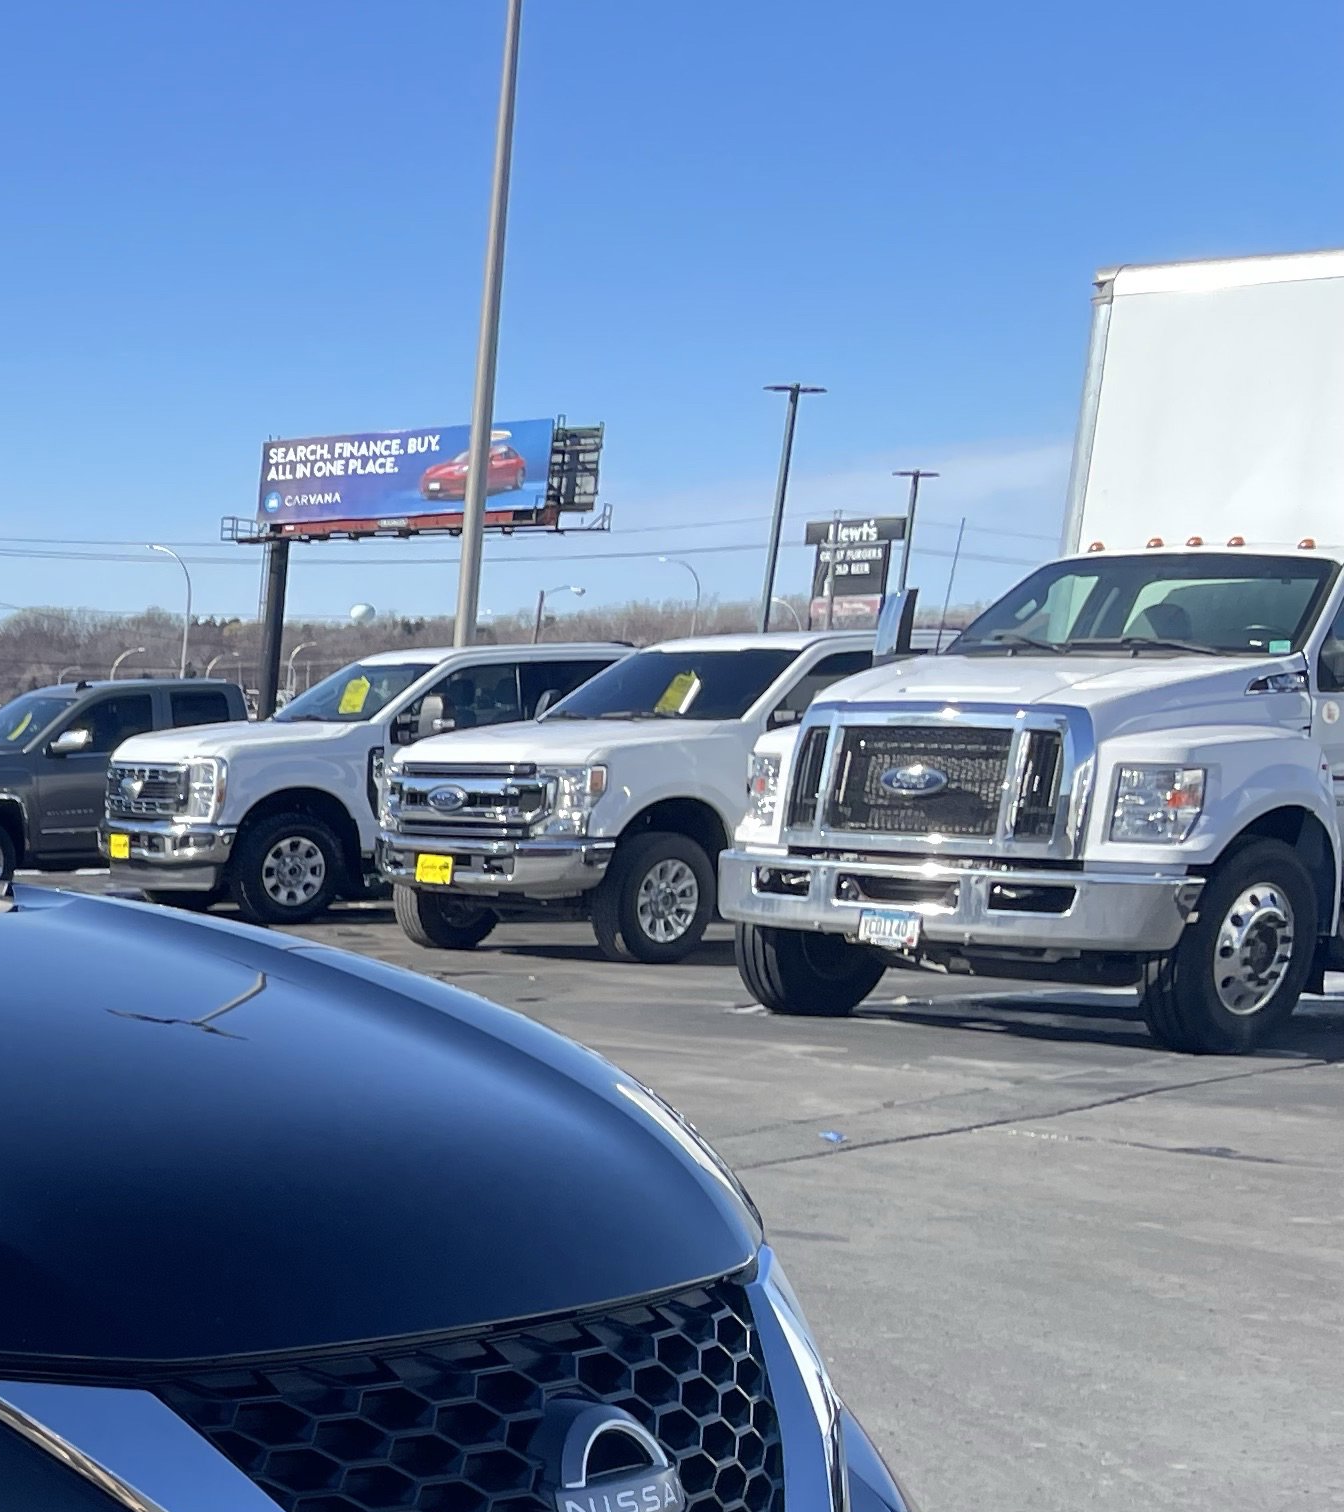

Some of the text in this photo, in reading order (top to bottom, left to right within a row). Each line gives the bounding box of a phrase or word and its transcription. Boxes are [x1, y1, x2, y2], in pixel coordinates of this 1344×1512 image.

[269, 434, 440, 464] SEARCH. FINANCE. BUY.
[267, 456, 399, 482] ALL IN ONE PLACE.
[284, 491, 342, 508] CARVANA
